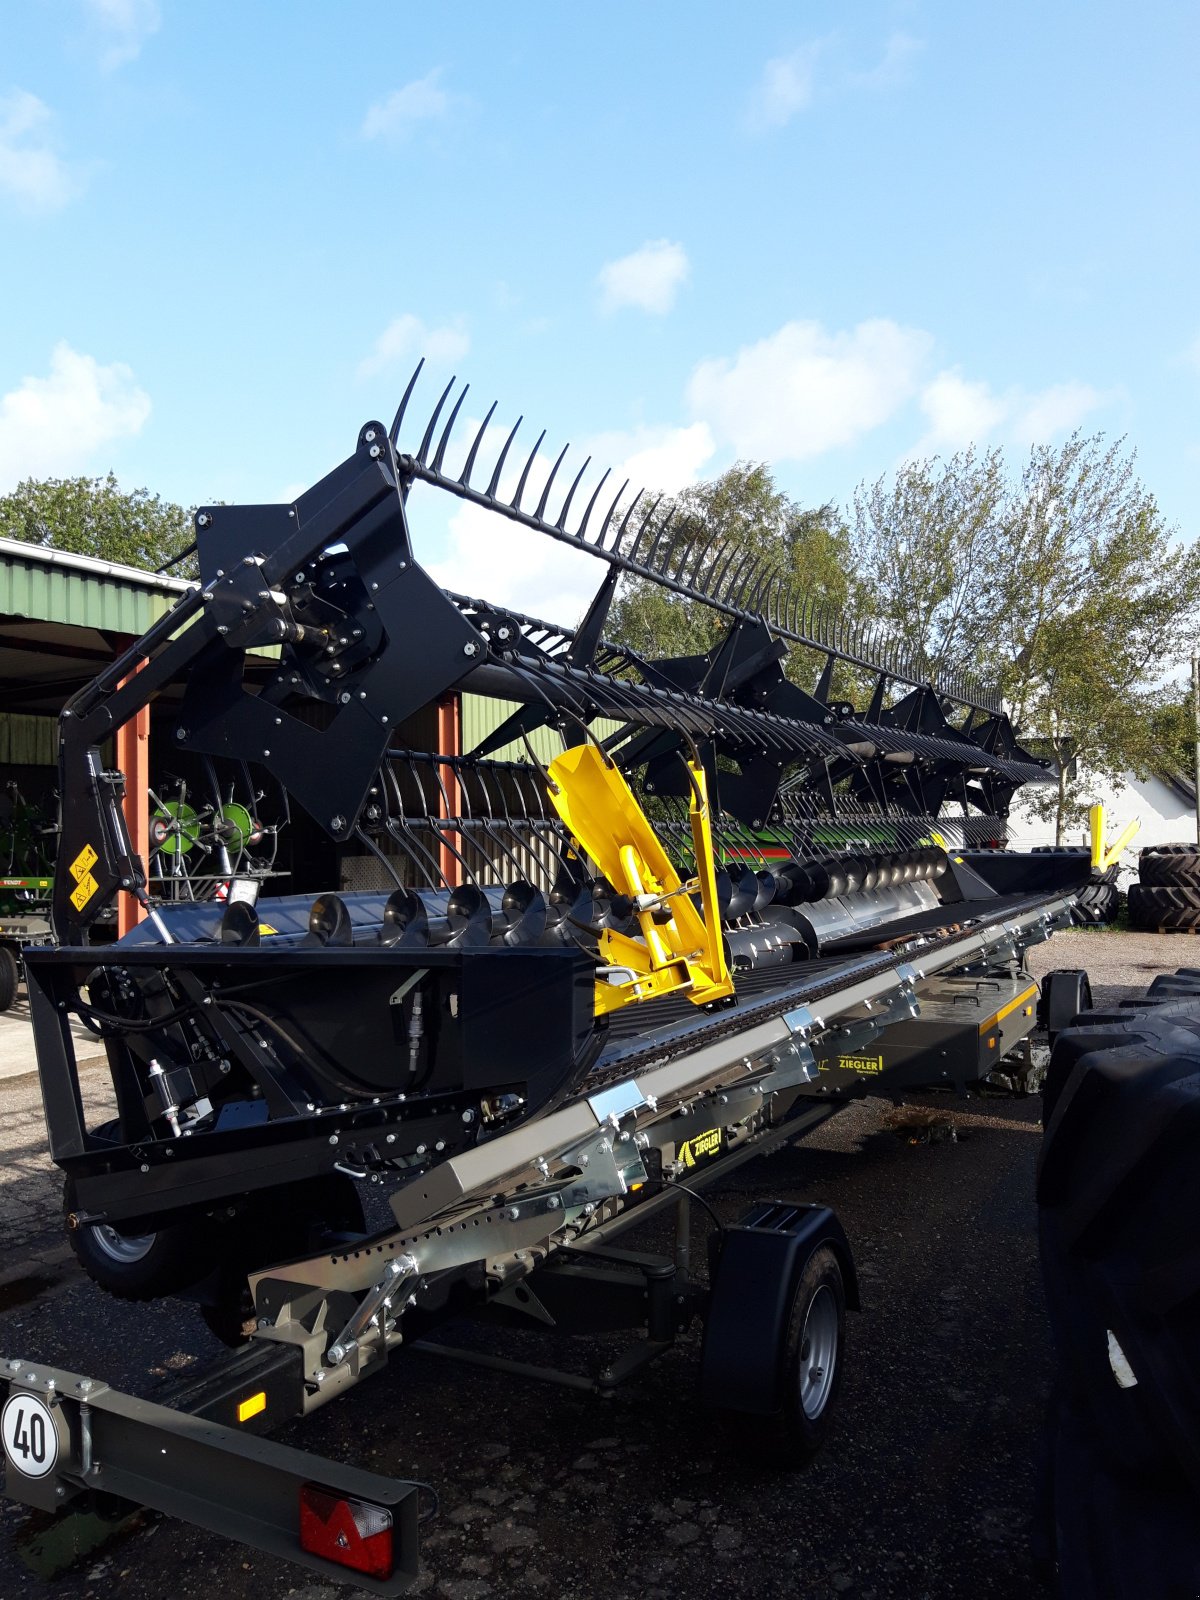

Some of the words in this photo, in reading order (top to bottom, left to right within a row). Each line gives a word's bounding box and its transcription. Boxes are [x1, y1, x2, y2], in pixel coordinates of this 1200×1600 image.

[839, 1059, 878, 1070] ZIEGLER
[694, 1133, 719, 1157] ZIEGLER
[13, 1409, 46, 1464] 40
